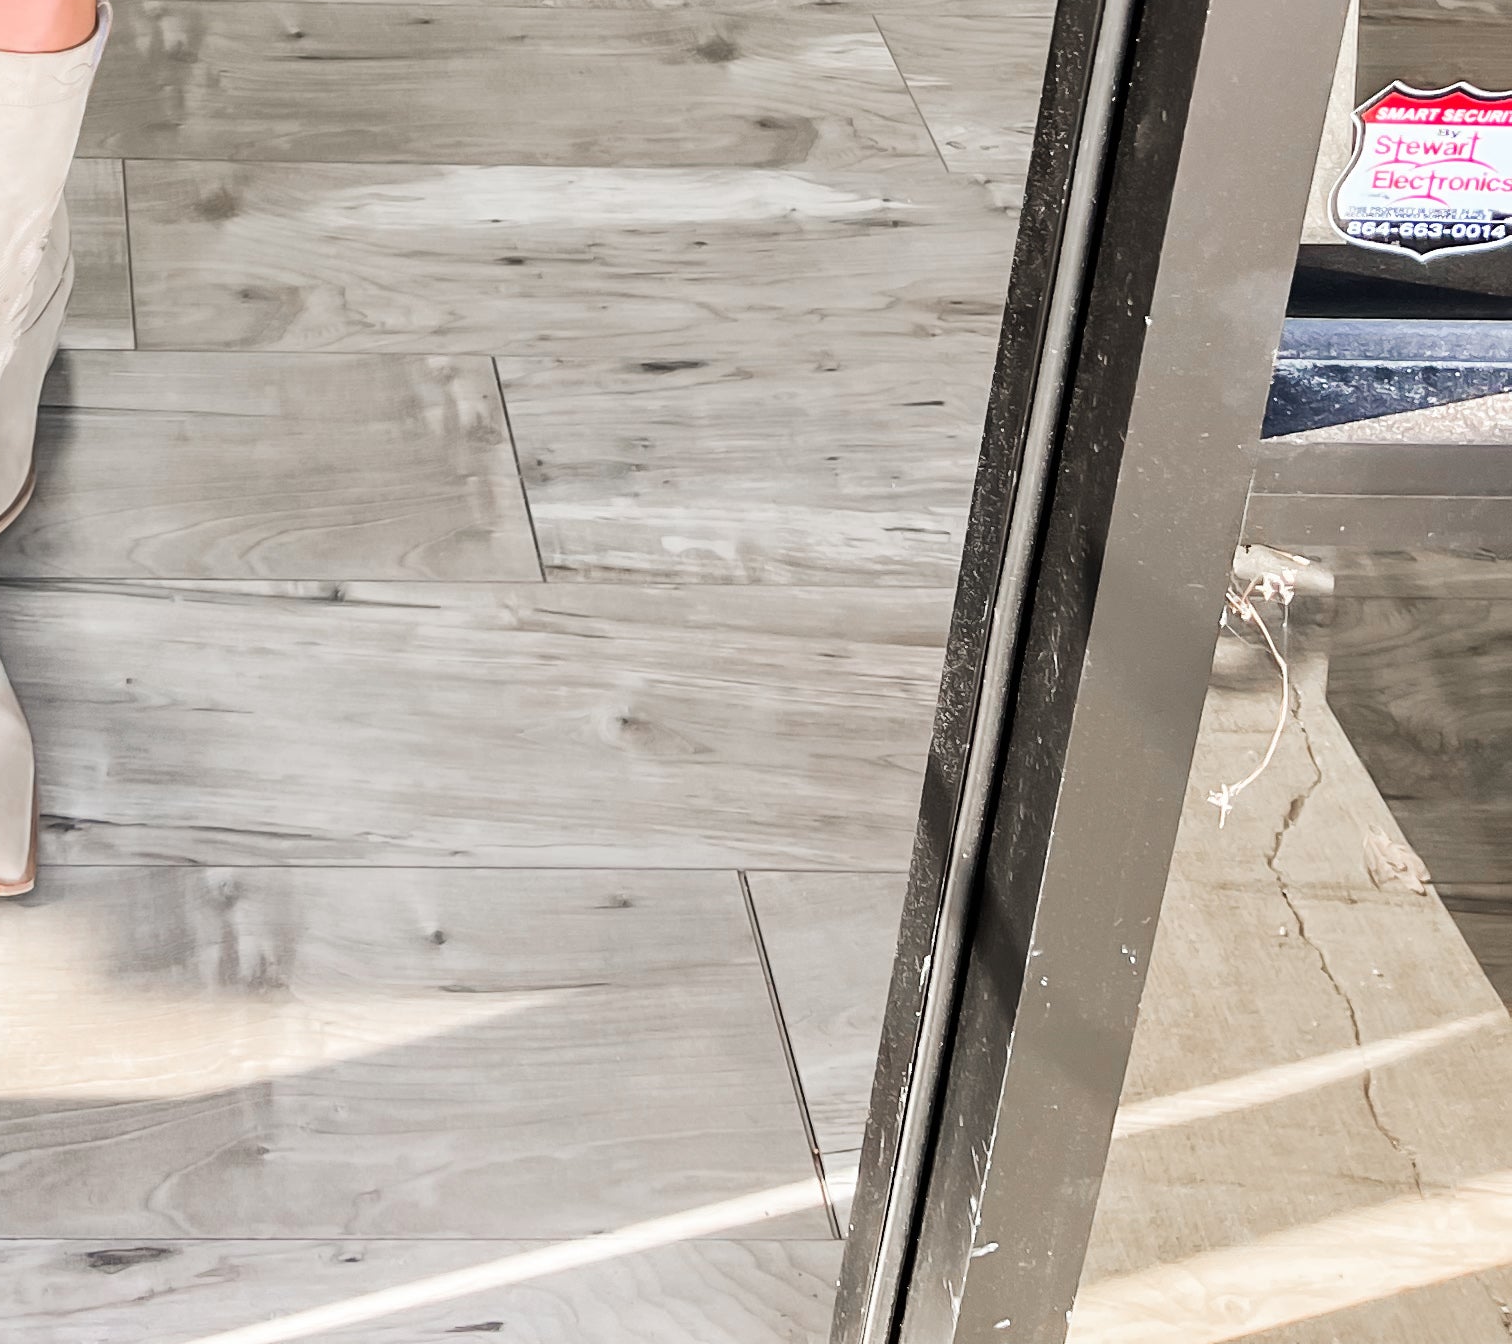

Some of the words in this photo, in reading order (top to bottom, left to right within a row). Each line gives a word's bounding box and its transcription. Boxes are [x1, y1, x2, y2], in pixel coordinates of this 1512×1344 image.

[1376, 106, 1441, 121] SMART
[1442, 108, 1512, 123] SECURIT
[1374, 131, 1483, 161] Stewart
[1371, 170, 1512, 198] Electronics
[1346, 221, 1506, 239] 864-663-0014
